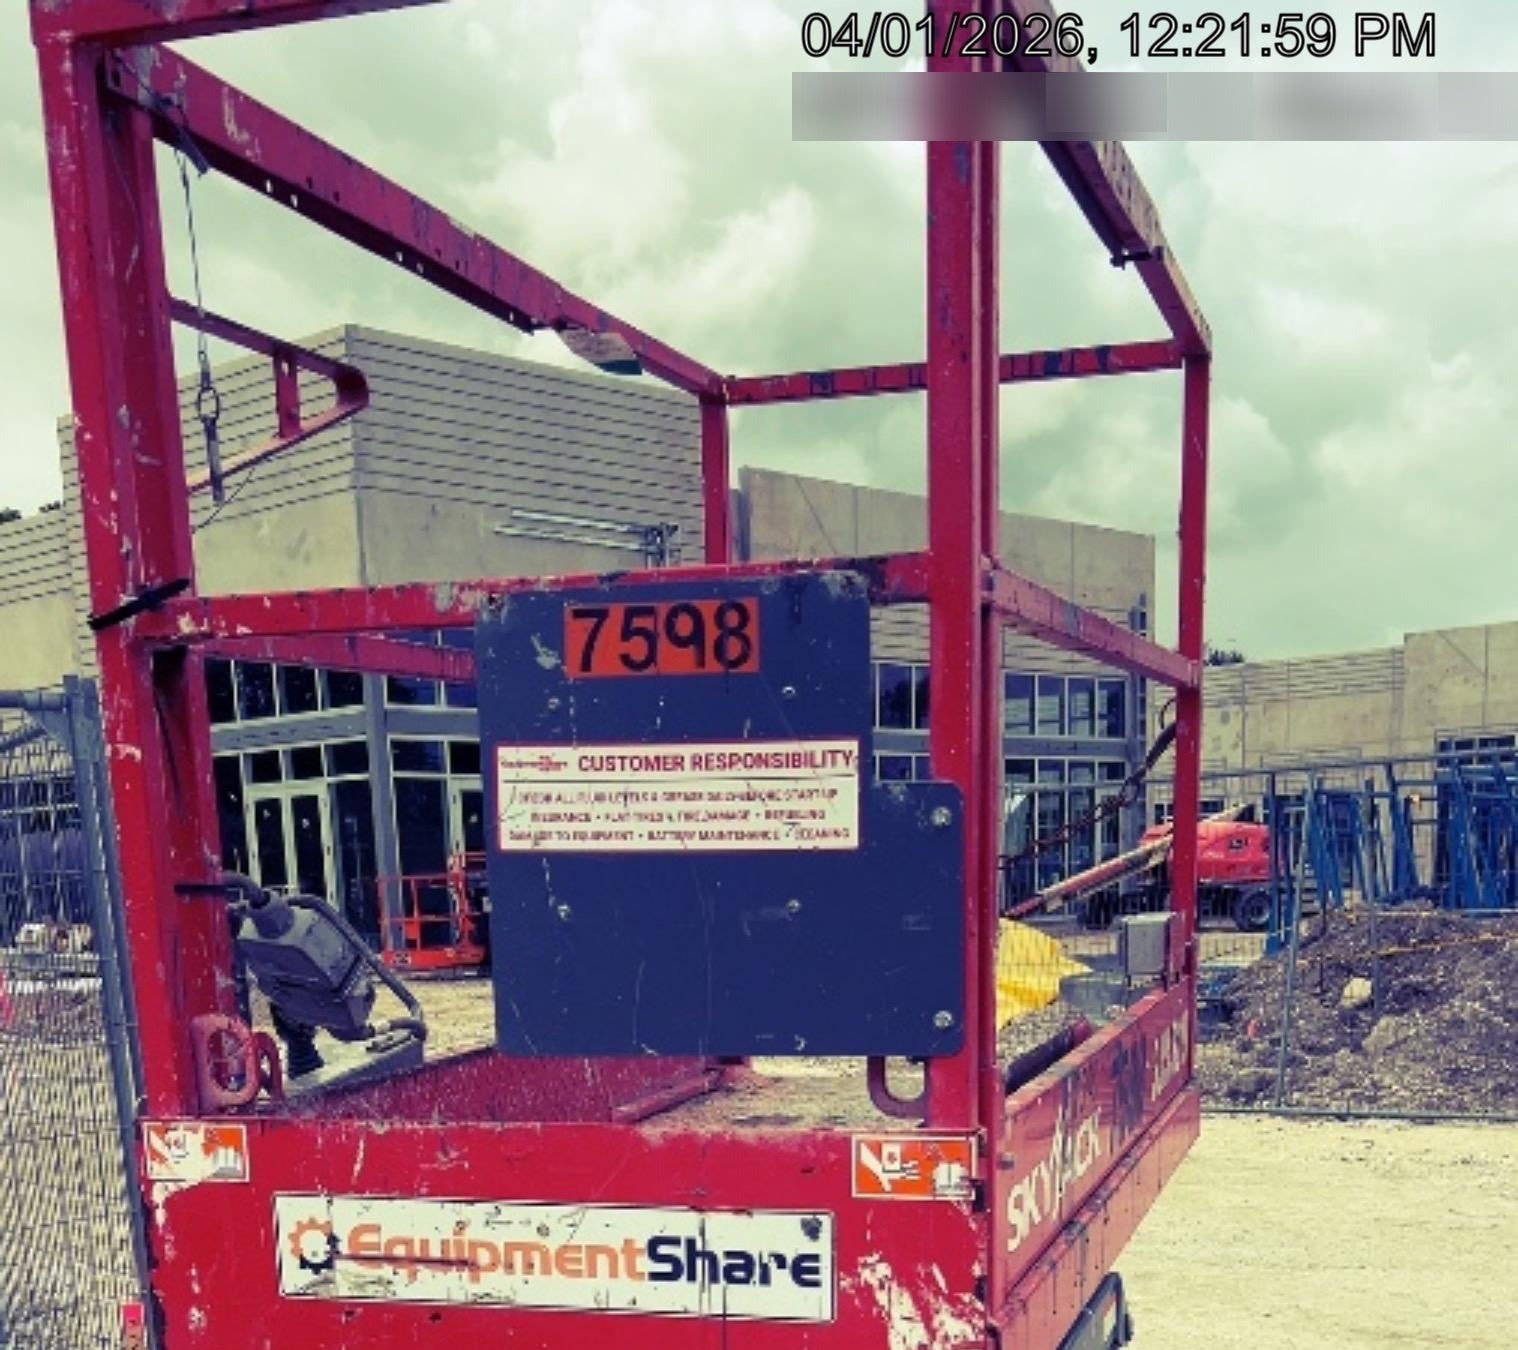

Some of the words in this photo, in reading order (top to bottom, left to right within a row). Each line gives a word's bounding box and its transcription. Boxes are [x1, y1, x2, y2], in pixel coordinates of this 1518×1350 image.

[572, 601, 752, 673] 7598
[577, 754, 685, 773] CUSTOMER
[690, 749, 854, 772] RESPONSIBILITY
[348, 1222, 823, 1288] EquipmentShare
